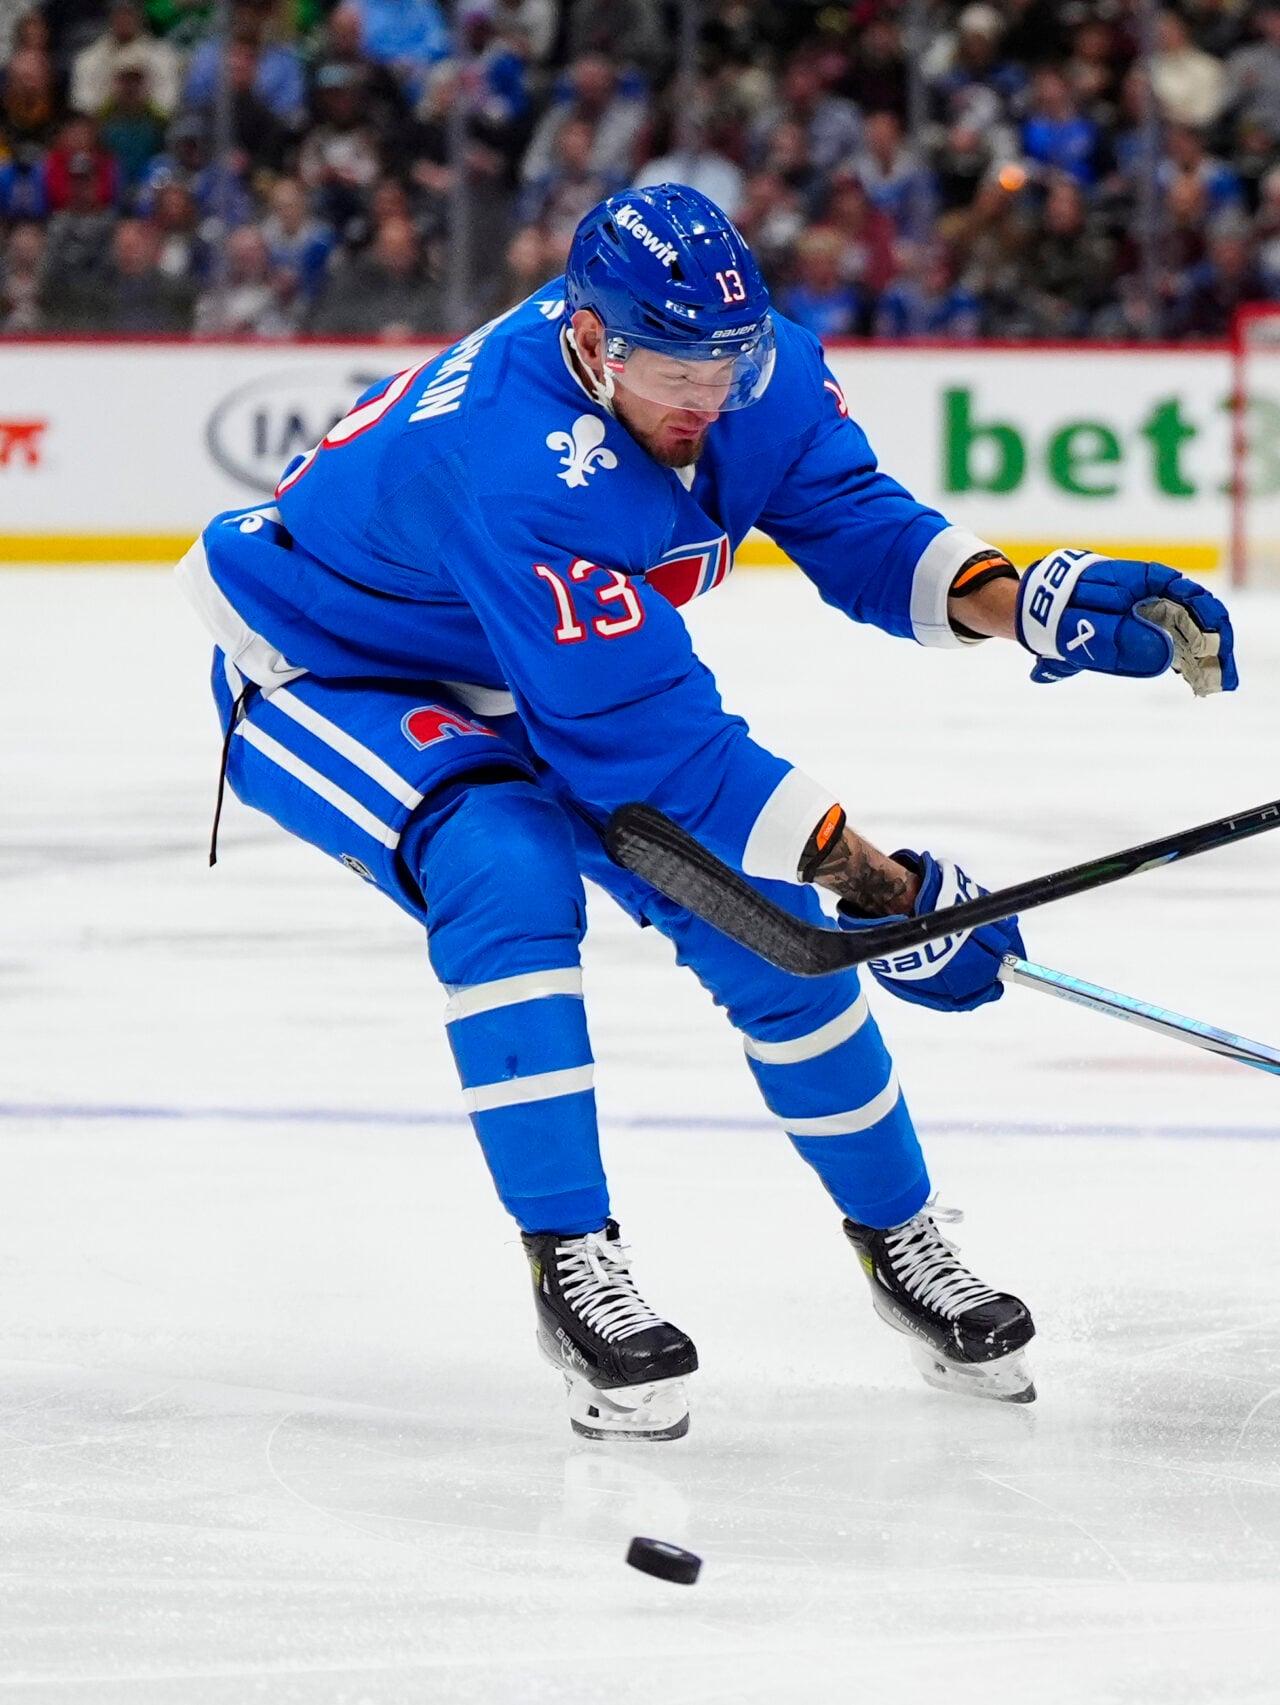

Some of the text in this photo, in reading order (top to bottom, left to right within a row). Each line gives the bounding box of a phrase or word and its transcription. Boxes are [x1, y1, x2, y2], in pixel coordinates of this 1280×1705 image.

[614, 204, 679, 267] Kiewit
[715, 269, 746, 304] 13
[533, 557, 645, 645] 13
